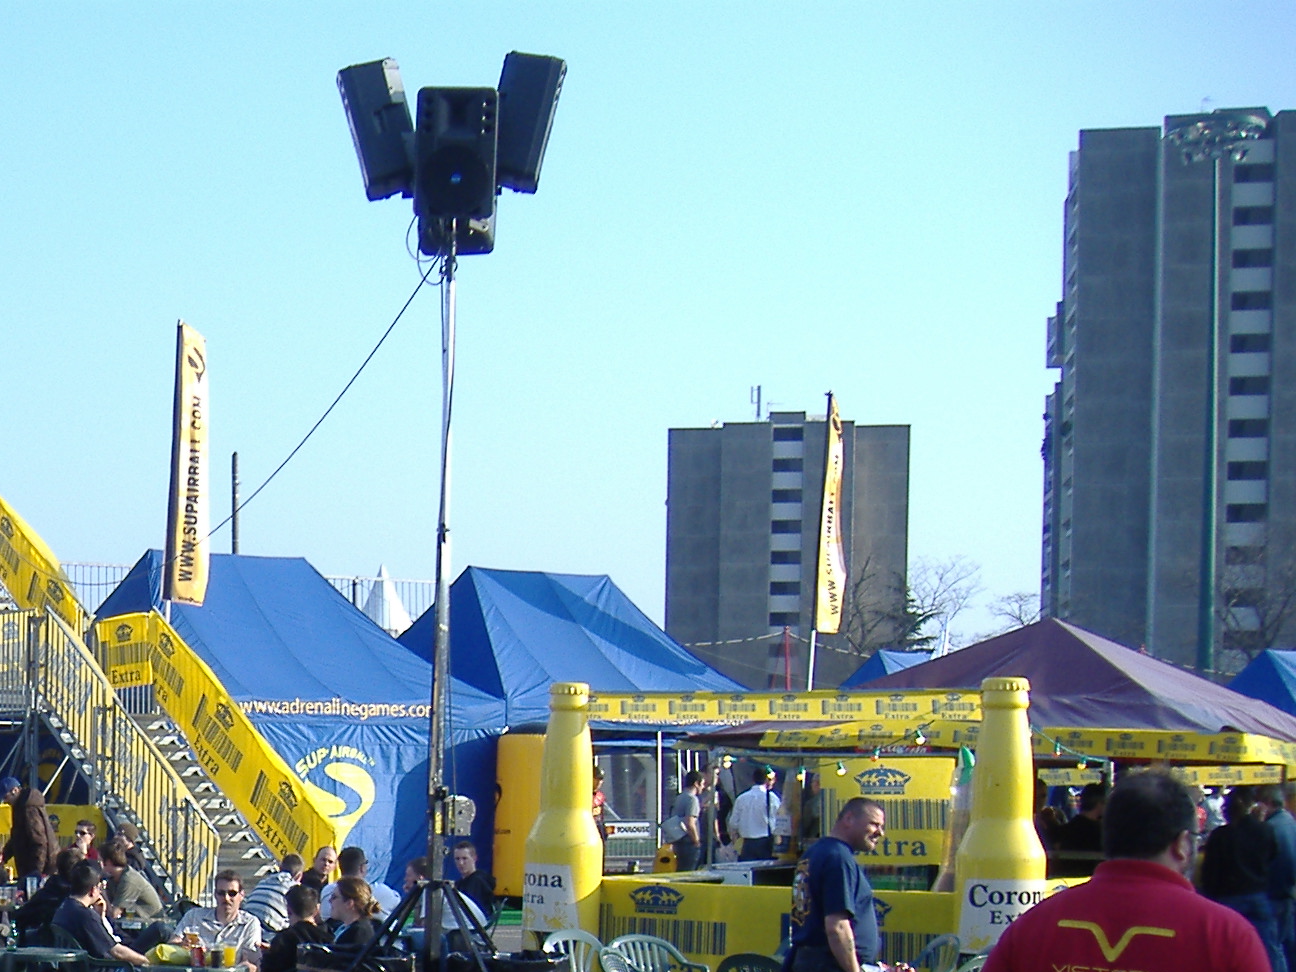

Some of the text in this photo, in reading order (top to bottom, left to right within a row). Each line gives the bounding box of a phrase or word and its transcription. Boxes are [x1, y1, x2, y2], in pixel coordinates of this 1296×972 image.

[111, 668, 141, 685] Extra
[255, 812, 288, 857] Extra
[969, 884, 1043, 907] Coron
